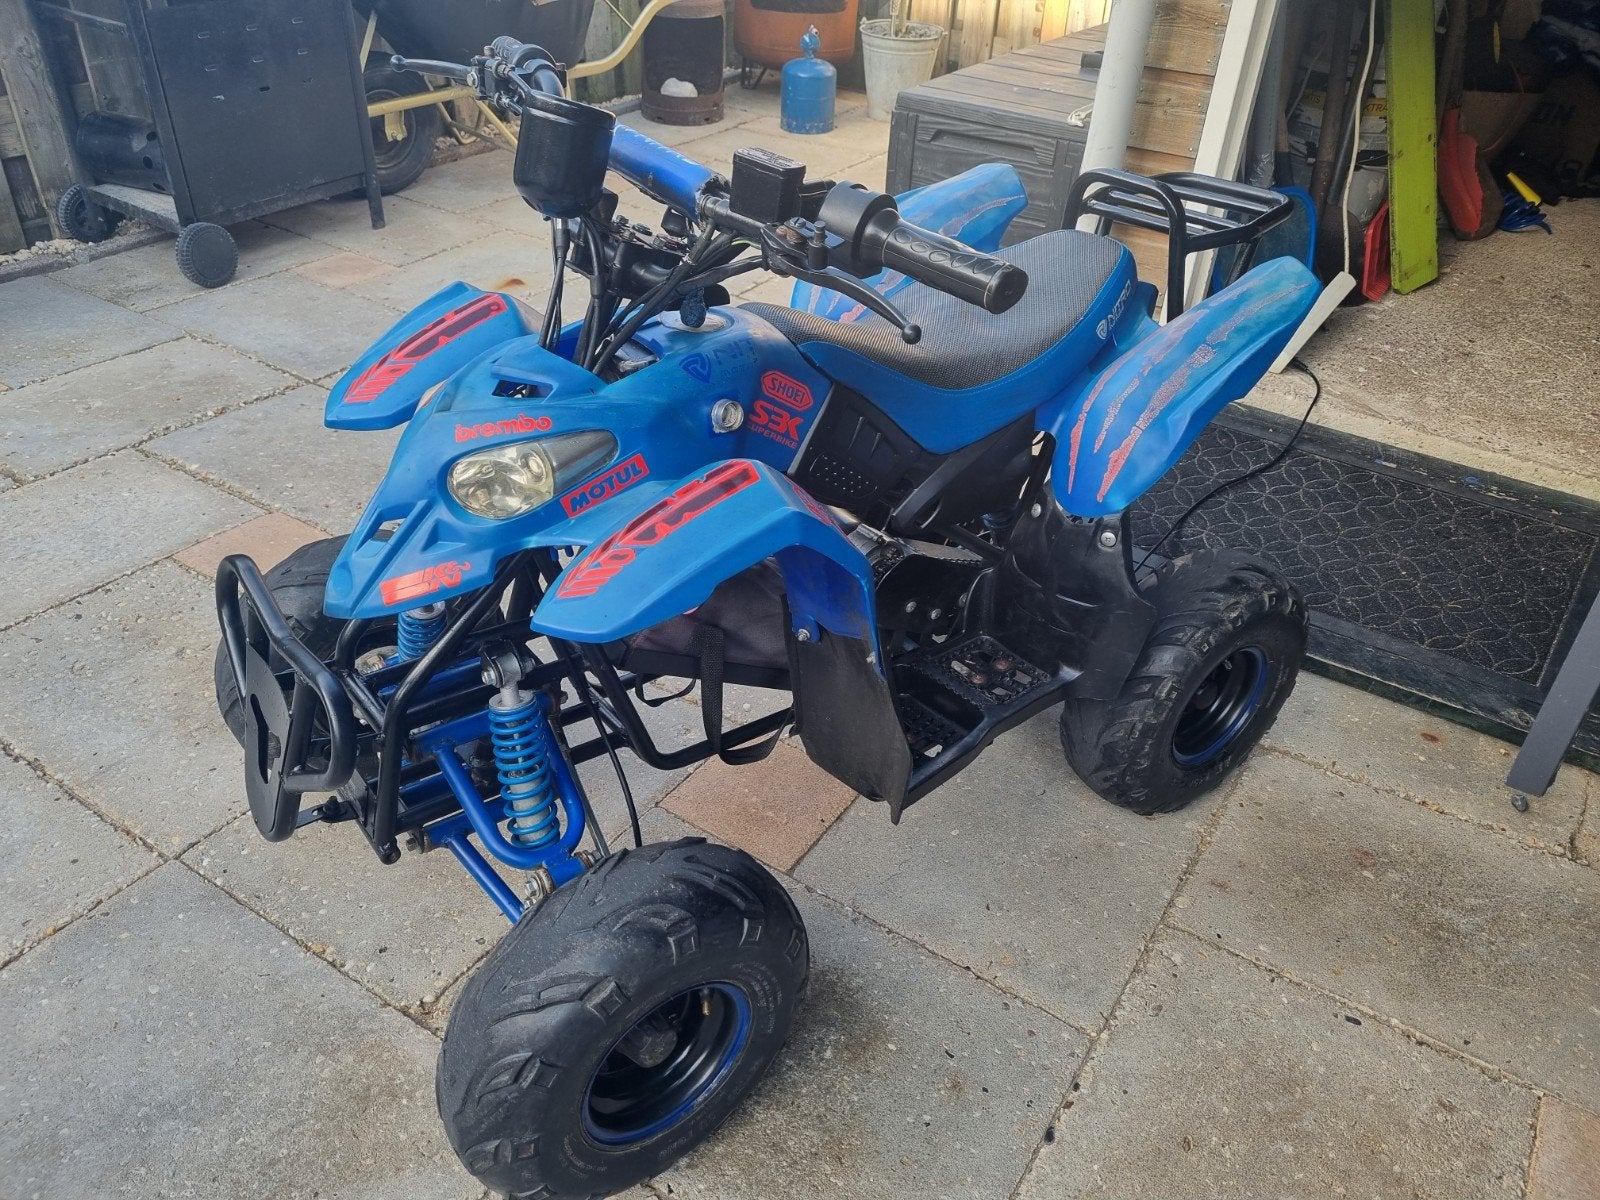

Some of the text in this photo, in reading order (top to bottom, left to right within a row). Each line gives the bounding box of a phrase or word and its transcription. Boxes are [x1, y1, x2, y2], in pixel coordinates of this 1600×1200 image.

[768, 376, 806, 405] SHOEI
[455, 413, 552, 443] brembo
[568, 461, 643, 514] MOTUL
